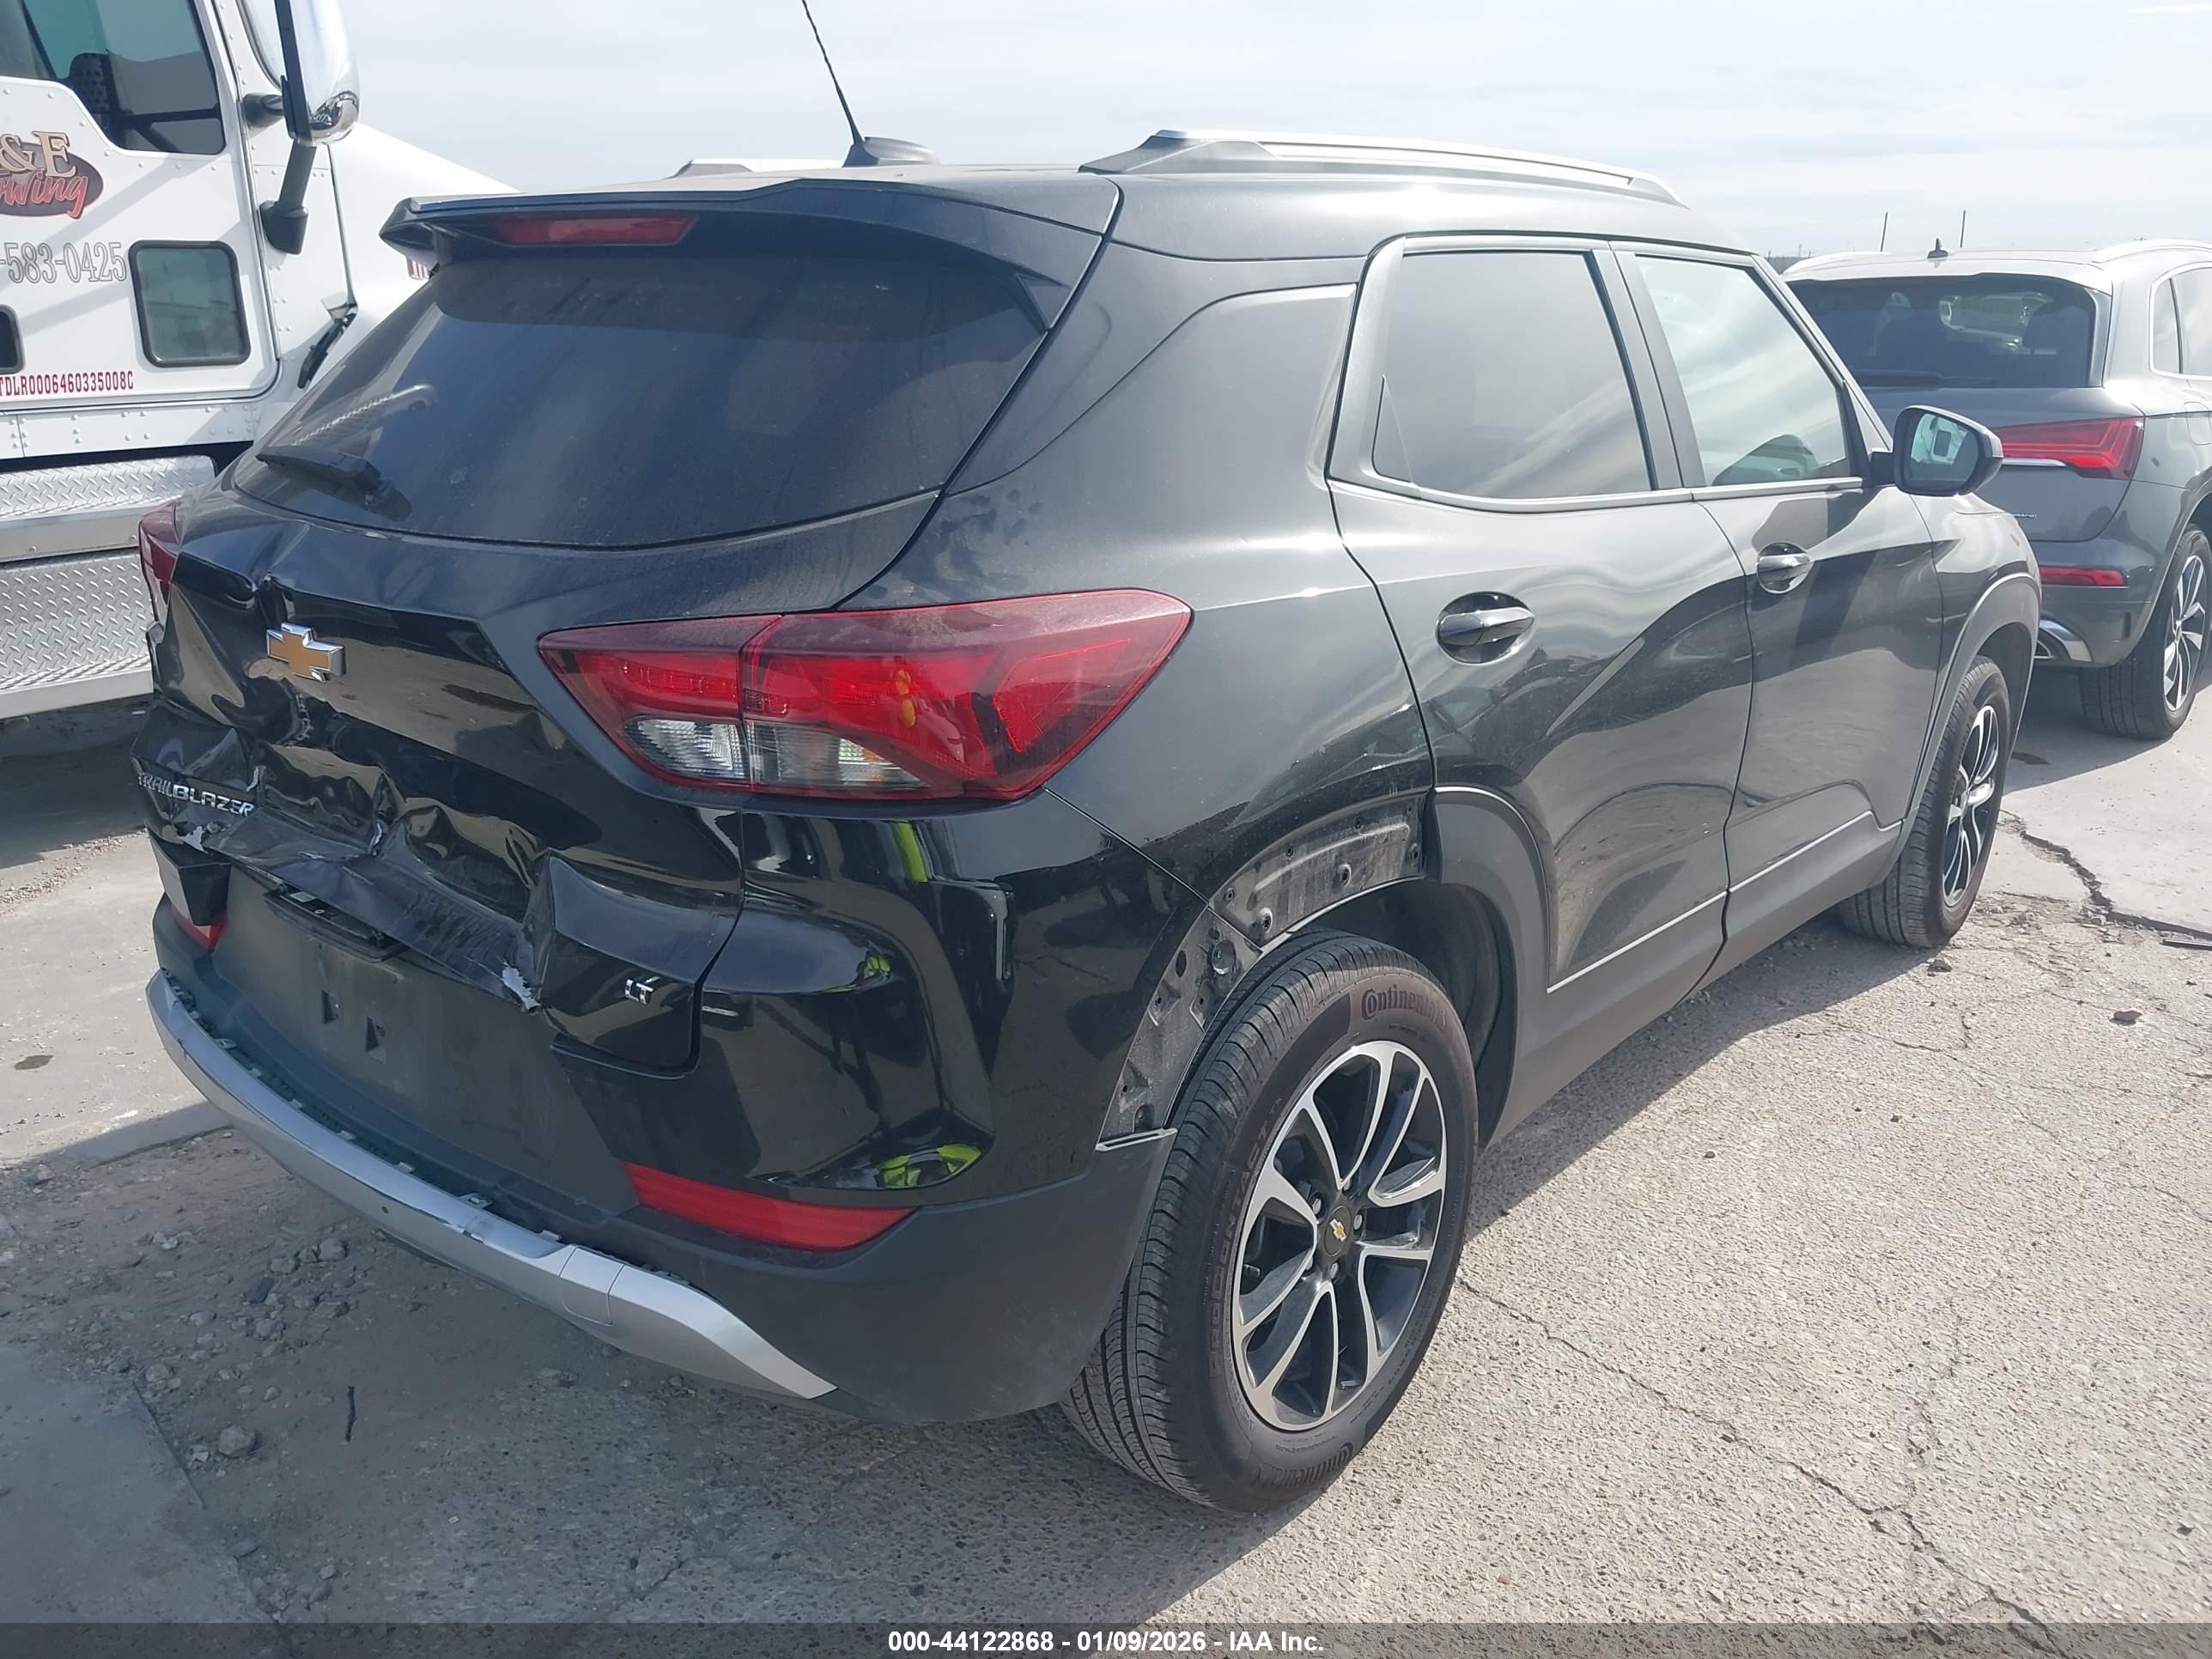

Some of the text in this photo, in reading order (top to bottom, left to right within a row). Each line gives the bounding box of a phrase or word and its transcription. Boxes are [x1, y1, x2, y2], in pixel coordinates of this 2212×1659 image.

[137, 772, 255, 817] TRAILBLAZER
[625, 978, 654, 1006] LT
[1361, 984, 1439, 1024] Continental
